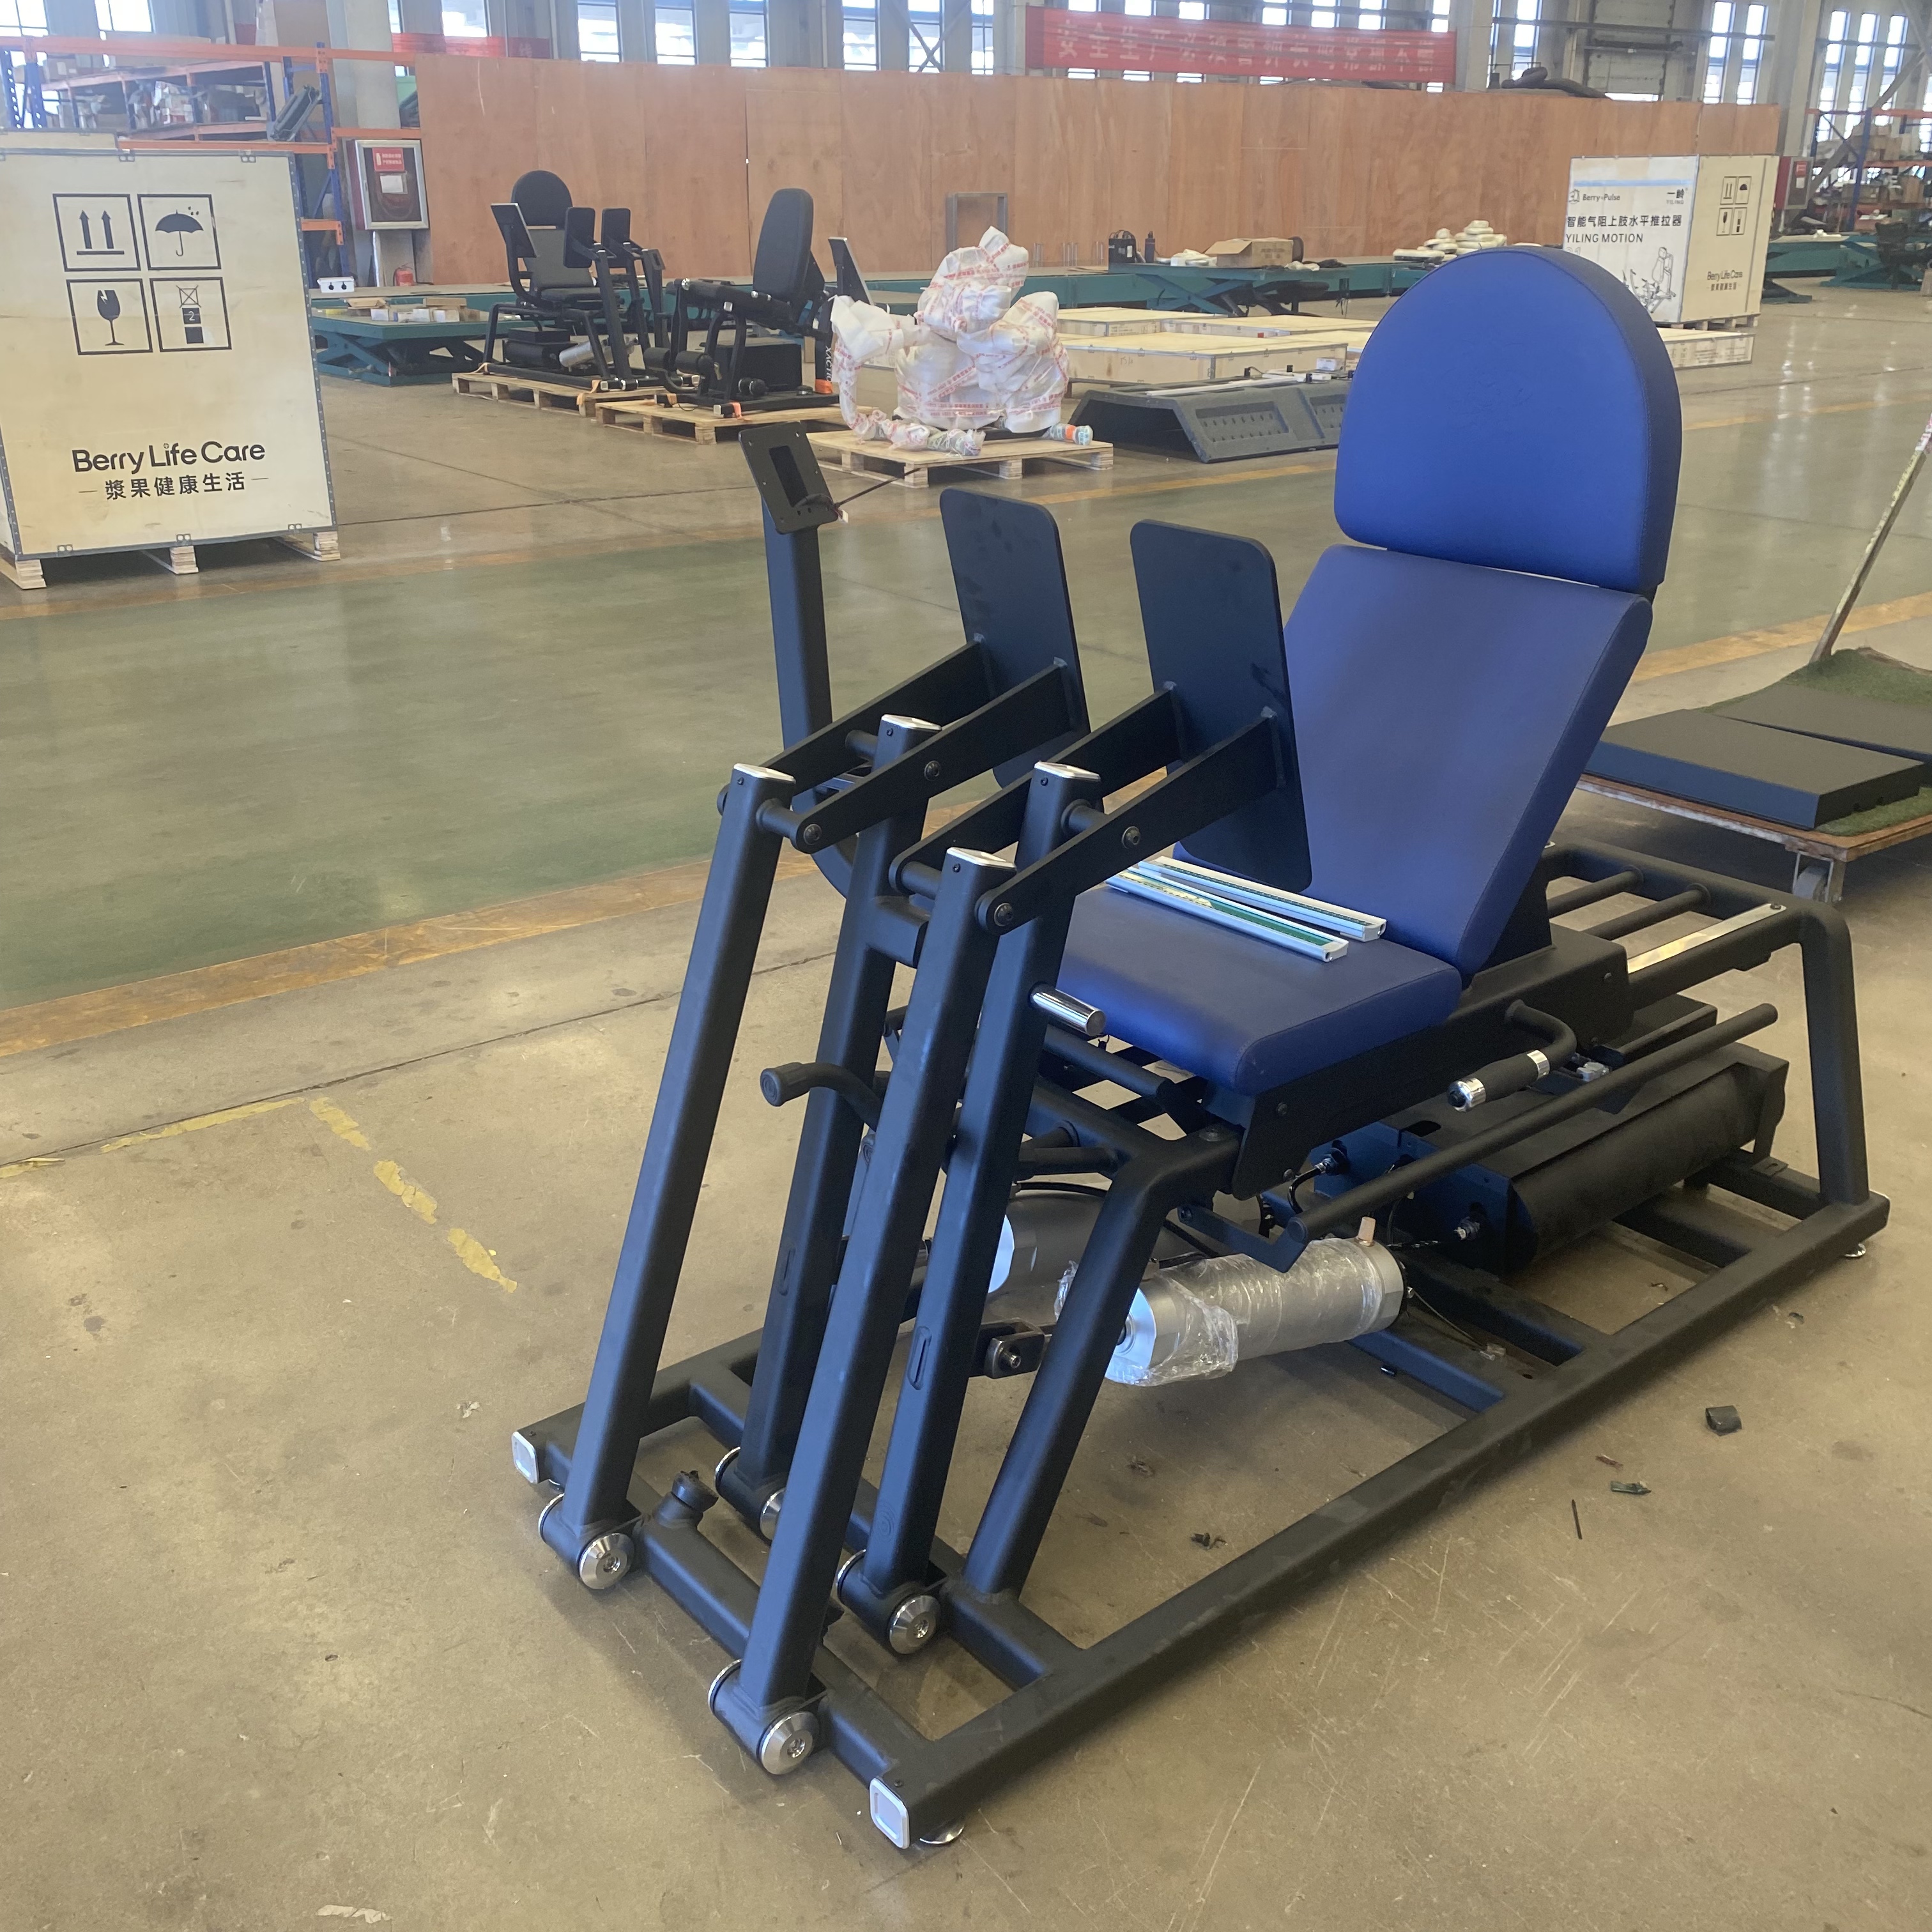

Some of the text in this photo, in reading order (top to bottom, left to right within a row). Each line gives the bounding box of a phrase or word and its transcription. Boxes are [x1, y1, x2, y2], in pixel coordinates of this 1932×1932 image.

[1567, 215, 1682, 227] 智能气阻上肢水平推拉器
[1566, 233, 1643, 243] YILING MOTION
[188, 310, 195, 321] 2
[72, 441, 266, 475] Berry Life Care
